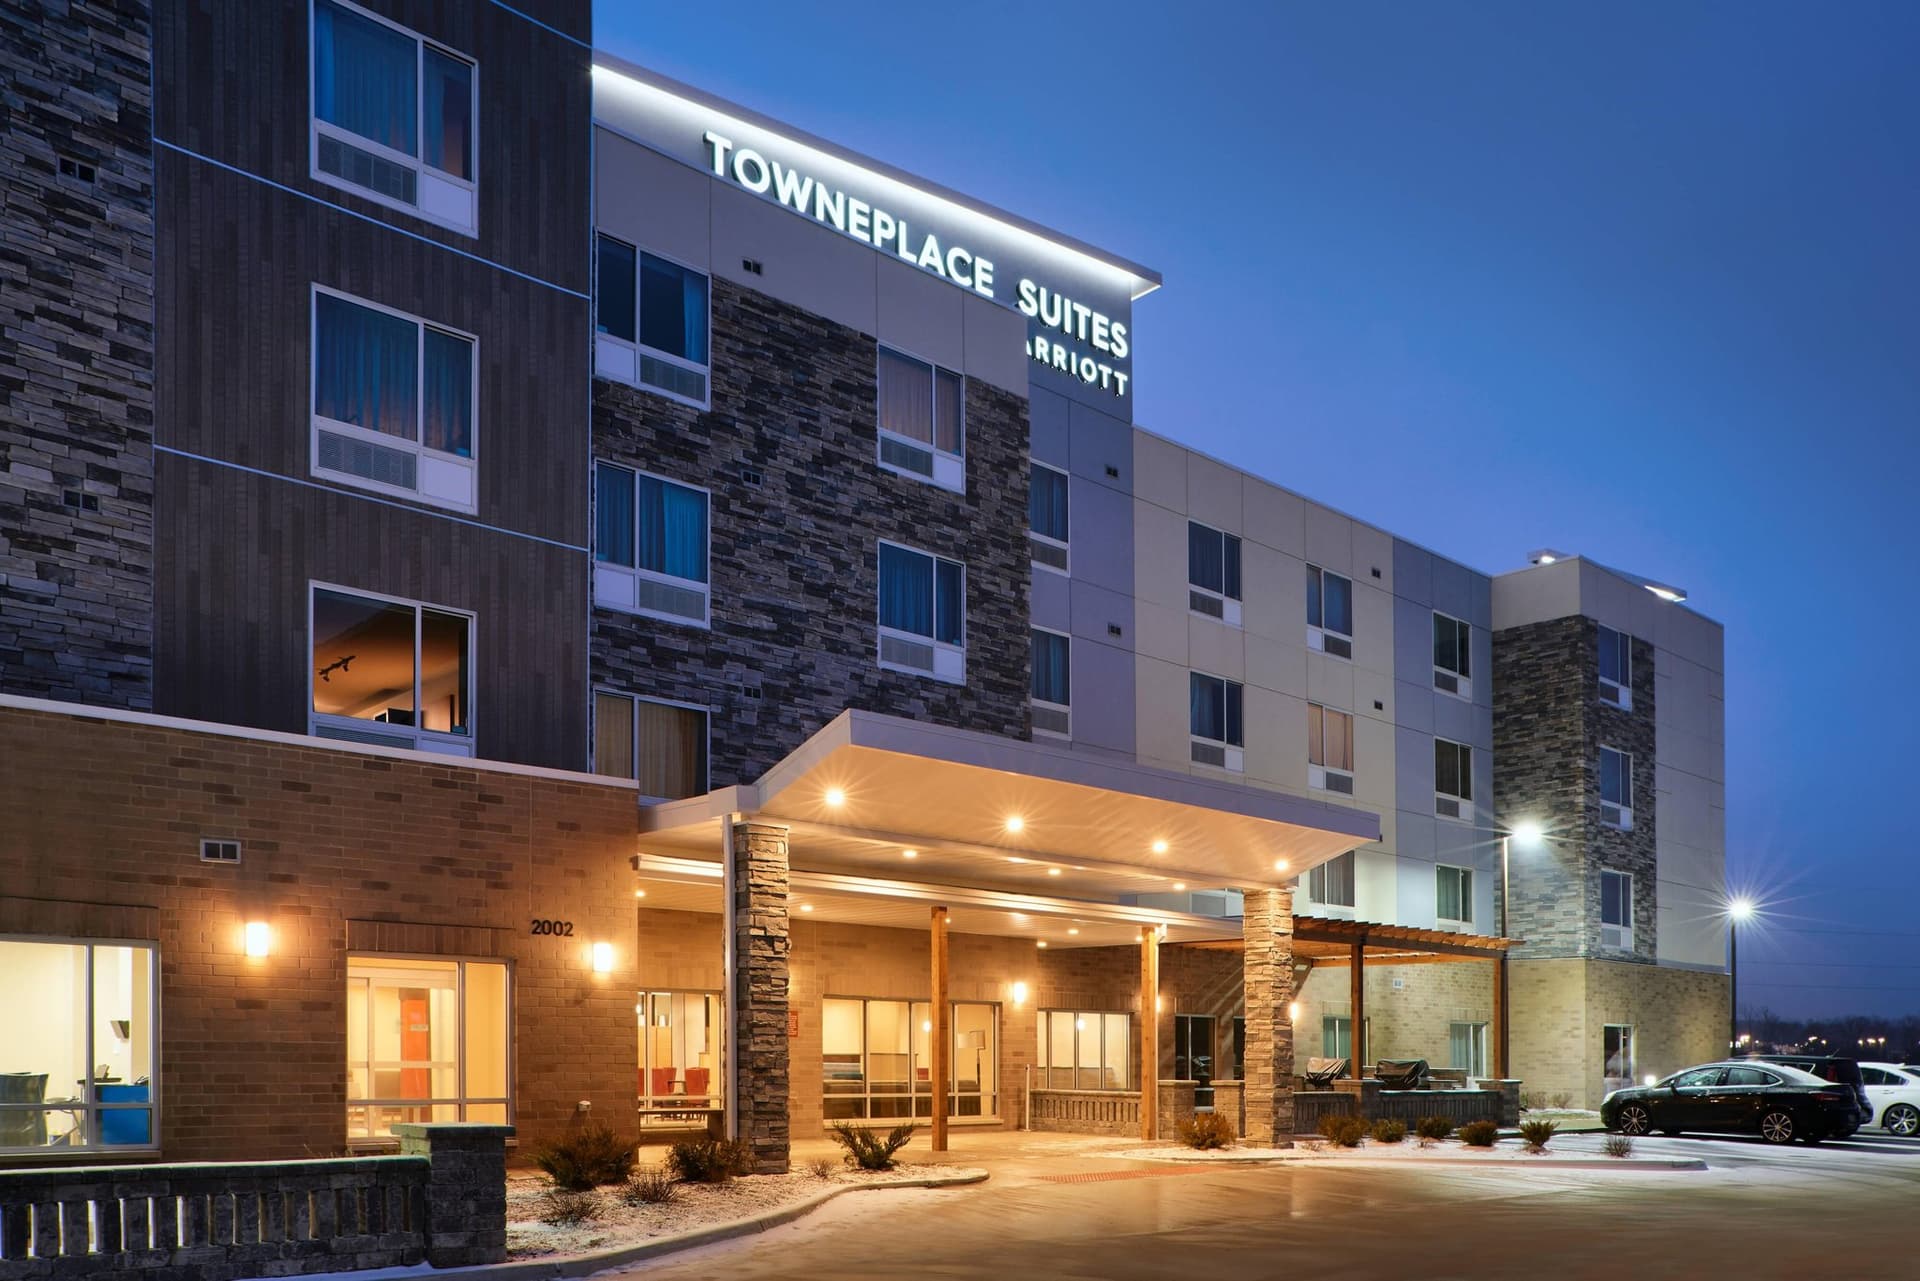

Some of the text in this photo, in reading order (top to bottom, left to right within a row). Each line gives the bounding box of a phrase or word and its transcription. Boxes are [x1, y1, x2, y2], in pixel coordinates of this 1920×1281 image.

[703, 130, 1128, 358] TOWNEPLACE SUITES
[531, 919, 574, 937] 2002
